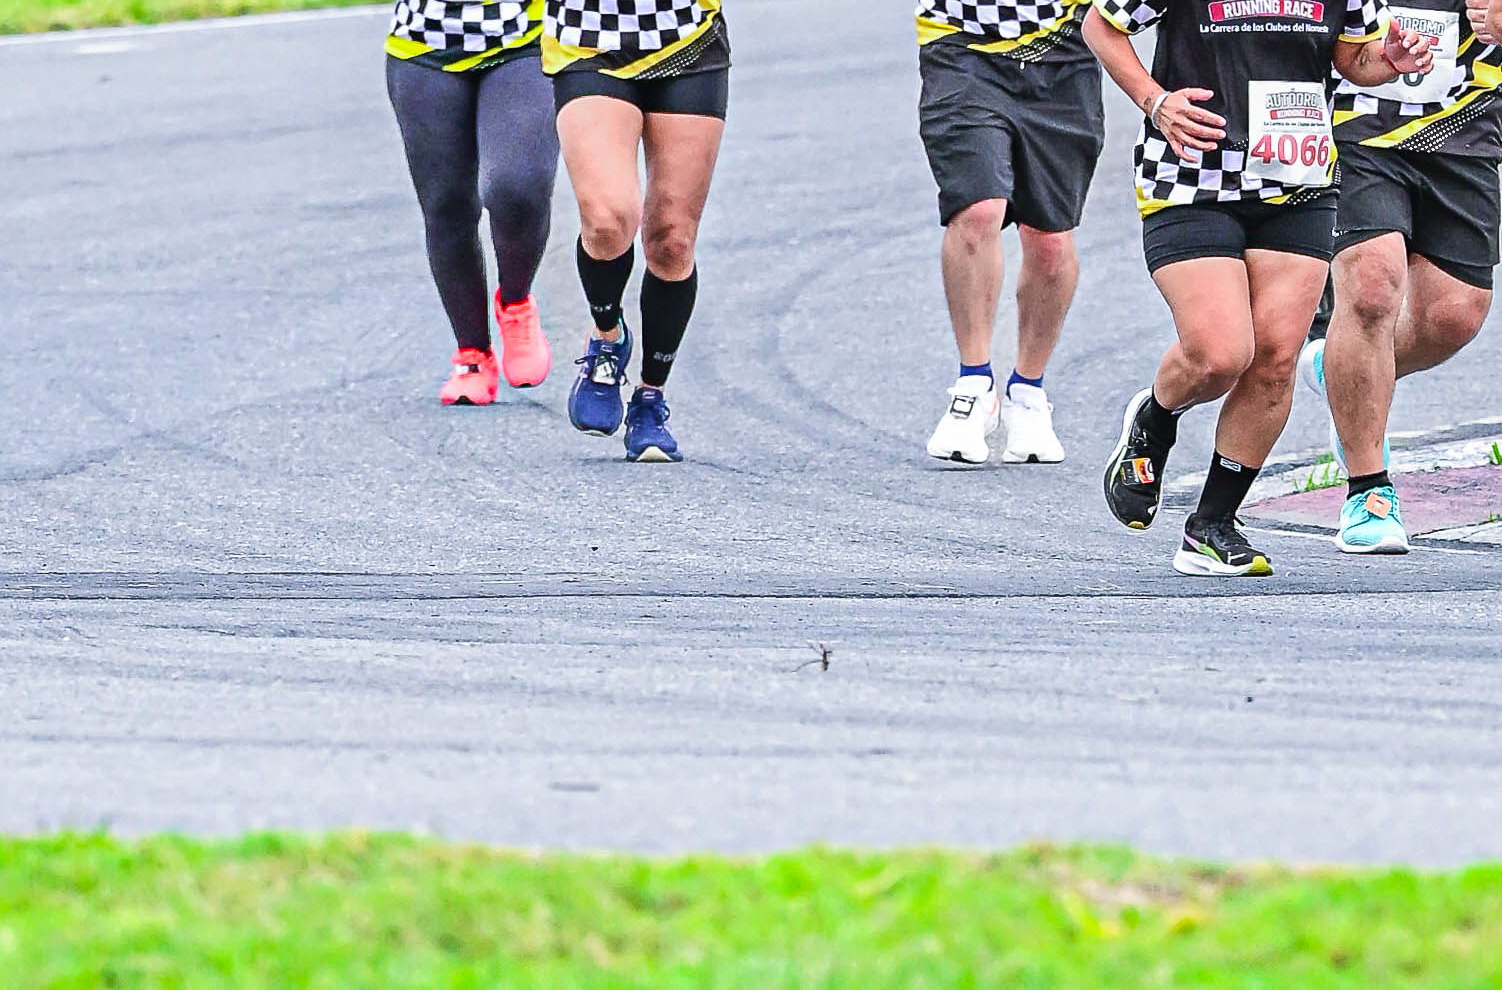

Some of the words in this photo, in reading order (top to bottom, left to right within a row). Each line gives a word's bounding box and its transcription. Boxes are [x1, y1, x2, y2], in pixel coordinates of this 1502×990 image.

[1222, 0, 1280, 19] RUNNING
[1283, 0, 1315, 19] RACE
[1199, 24, 1210, 33] La
[1210, 23, 1240, 33] Carrera
[1240, 22, 1252, 32] de
[1253, 22, 1265, 32] los
[1265, 22, 1292, 33] Clubes
[1292, 23, 1304, 32] del
[1250, 133, 1330, 167] 4066
